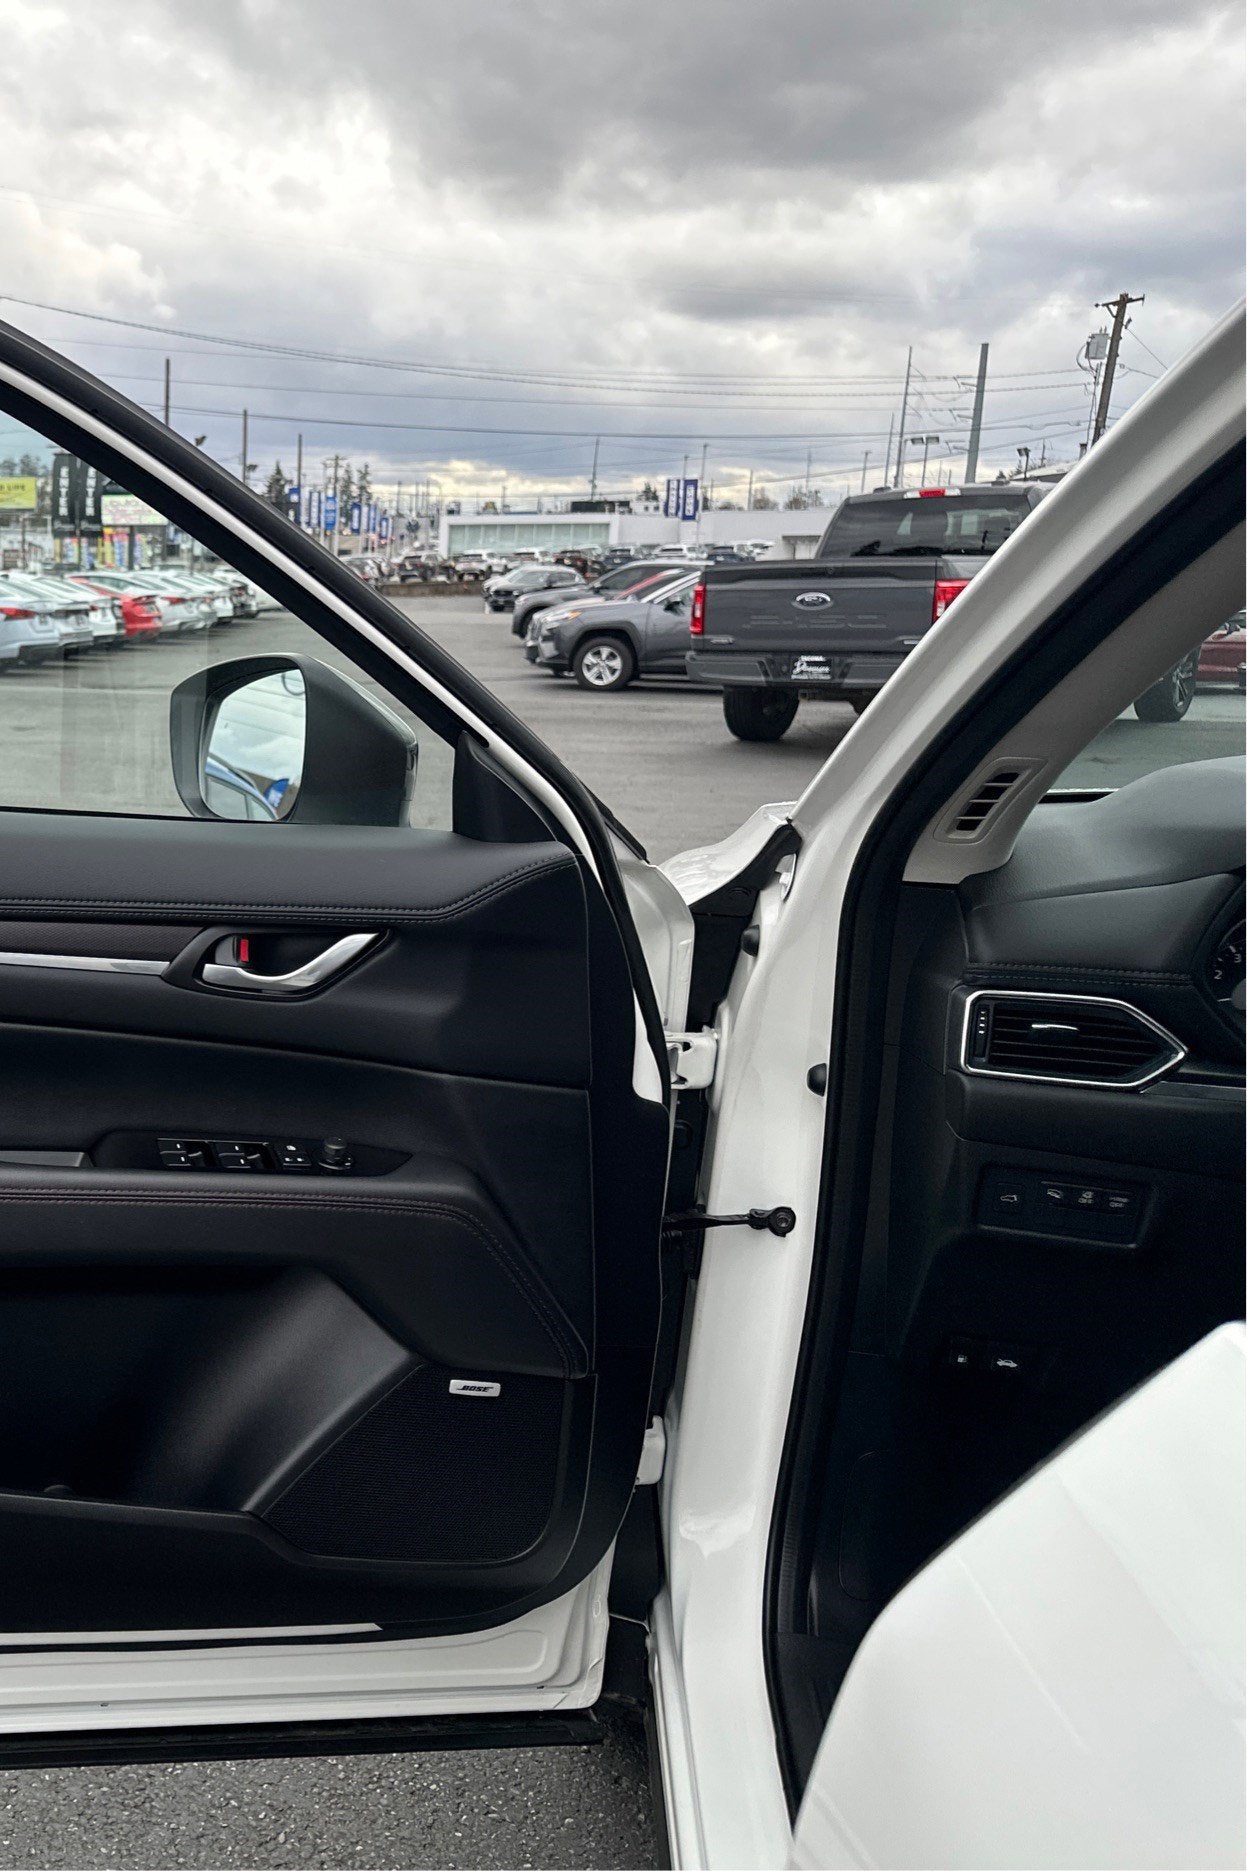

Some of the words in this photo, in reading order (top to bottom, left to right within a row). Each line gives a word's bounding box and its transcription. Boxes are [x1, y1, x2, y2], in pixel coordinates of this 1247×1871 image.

[58, 466, 70, 516] ENTER
[1234, 953, 1242, 963] 3
[1214, 969, 1223, 980] 2
